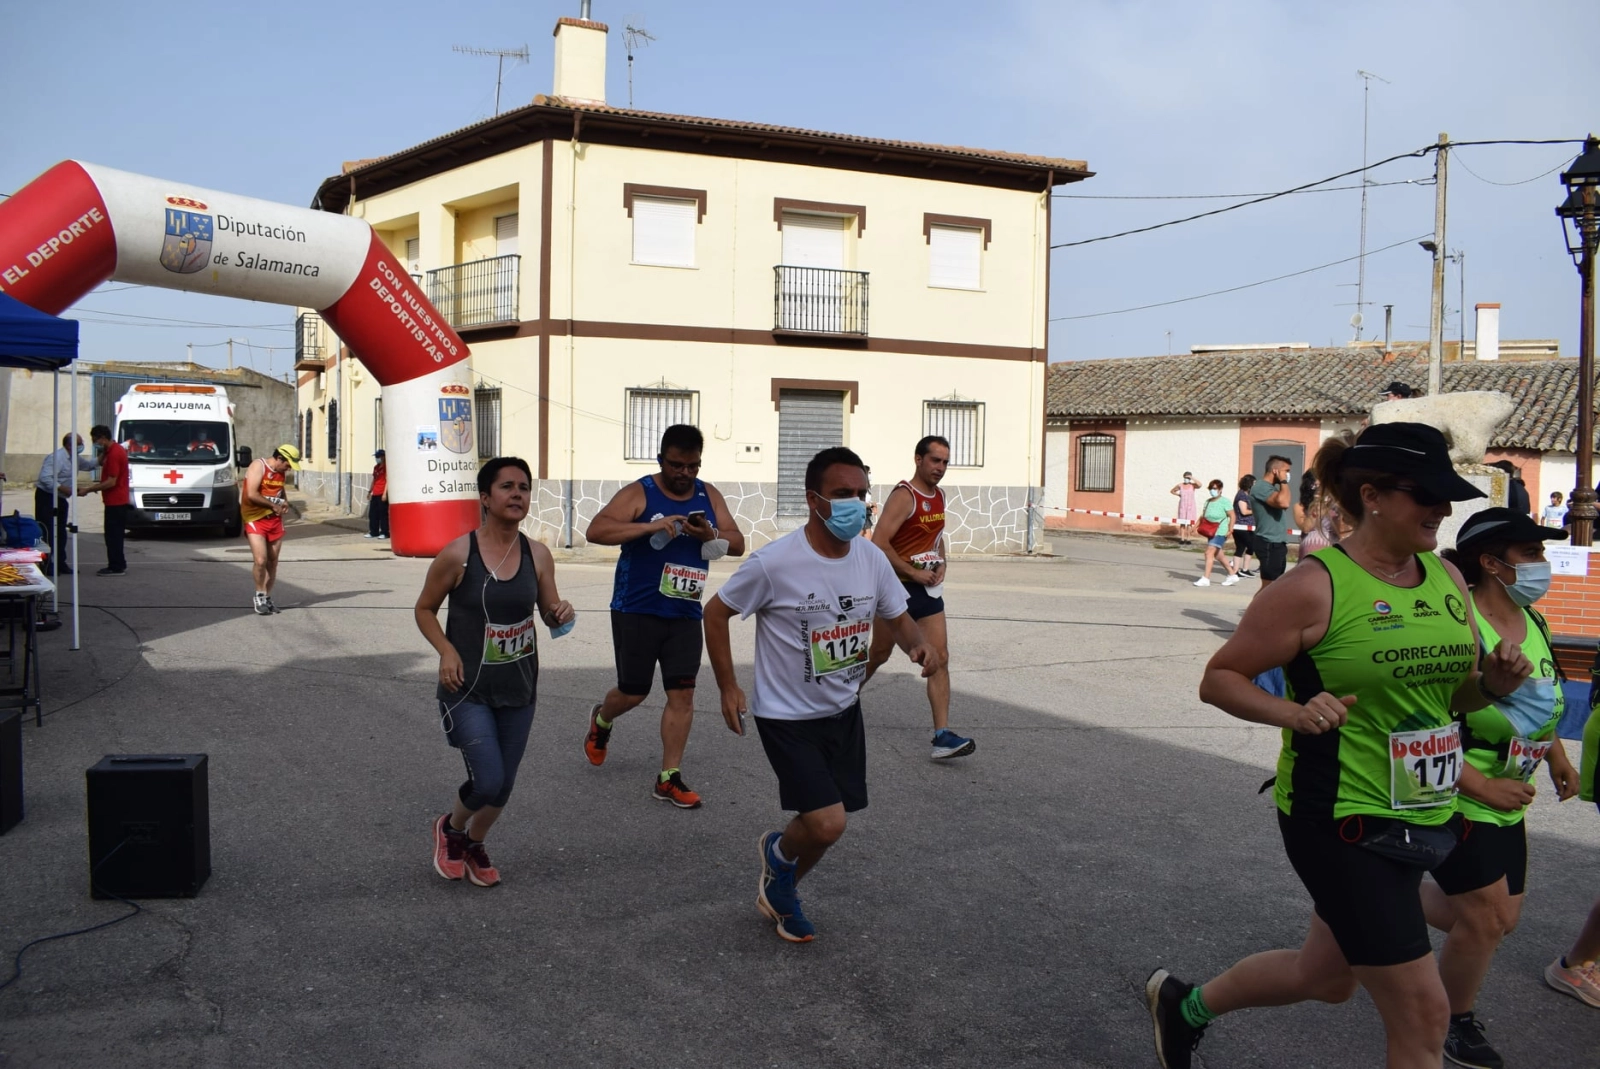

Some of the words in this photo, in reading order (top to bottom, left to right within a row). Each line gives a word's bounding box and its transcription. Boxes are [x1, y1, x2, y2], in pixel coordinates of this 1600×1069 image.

[217, 214, 307, 243] Diputación
[1, 264, 30, 286] EL
[26, 206, 105, 268] DEPORTE
[213, 252, 229, 266] de
[235, 251, 320, 278] Salamanca
[369, 277, 445, 363] DEPORTISTAS
[377, 260, 403, 291] CON
[402, 289, 458, 356] NUESTROS
[421, 483, 434, 495] de
[439, 479, 478, 493] Salama
[663, 564, 706, 581] bedunia
[671, 576, 698, 592] 115
[486, 619, 534, 639] bedunia
[811, 620, 871, 644] bedunia
[497, 633, 525, 655] 111
[825, 635, 860, 661] 112
[1391, 730, 1462, 760] bedunia
[1413, 752, 1457, 788] 177
